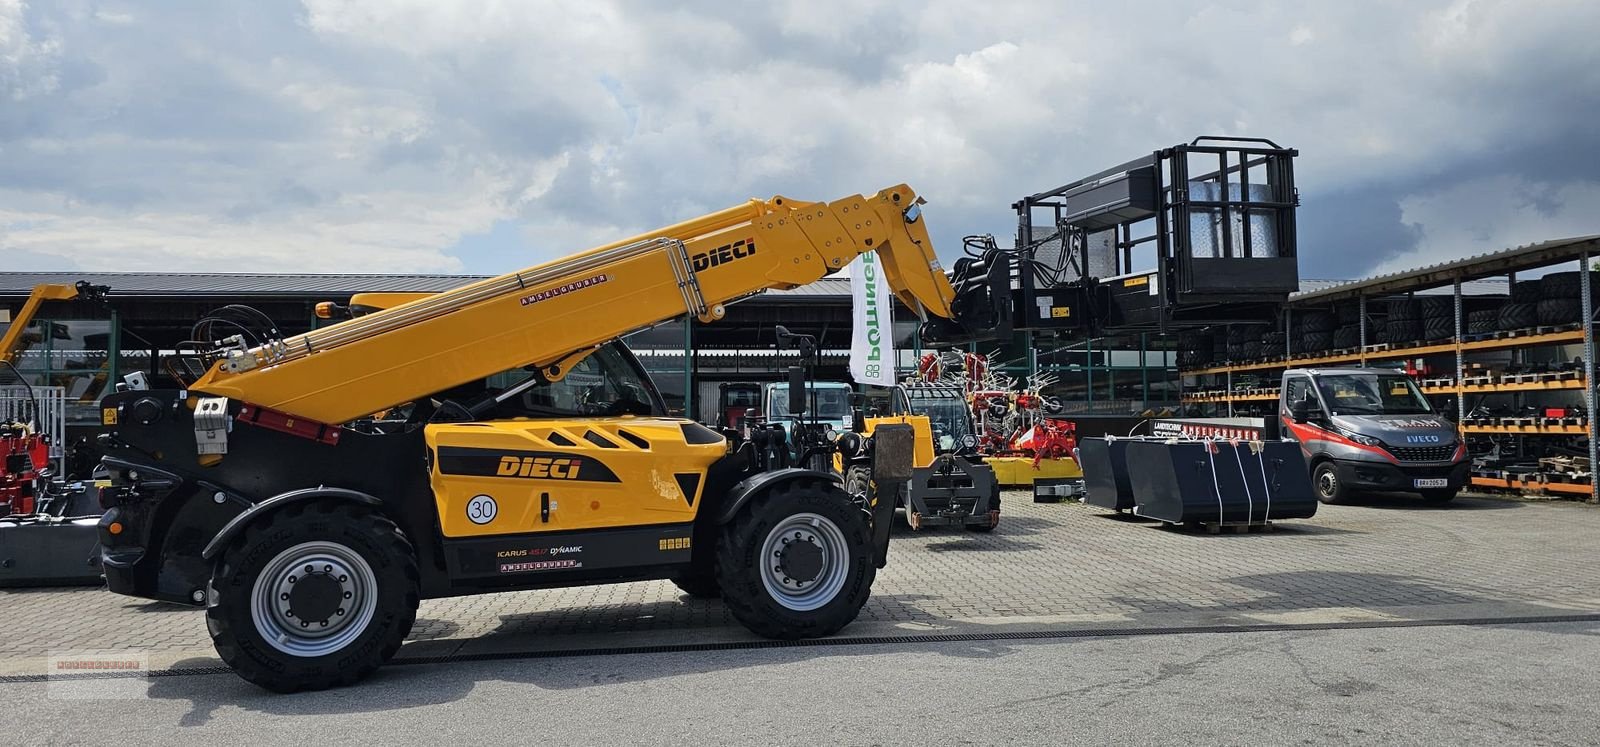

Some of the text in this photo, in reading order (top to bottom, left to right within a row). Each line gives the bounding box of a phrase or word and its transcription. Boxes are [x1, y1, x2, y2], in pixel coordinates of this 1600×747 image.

[692, 238, 756, 273] DIECI
[1406, 435, 1439, 443] IVECO
[497, 456, 581, 479] DIECI
[471, 501, 493, 518] 30
[497, 550, 527, 558] ICARUS
[550, 546, 583, 556] DYNAMIC
